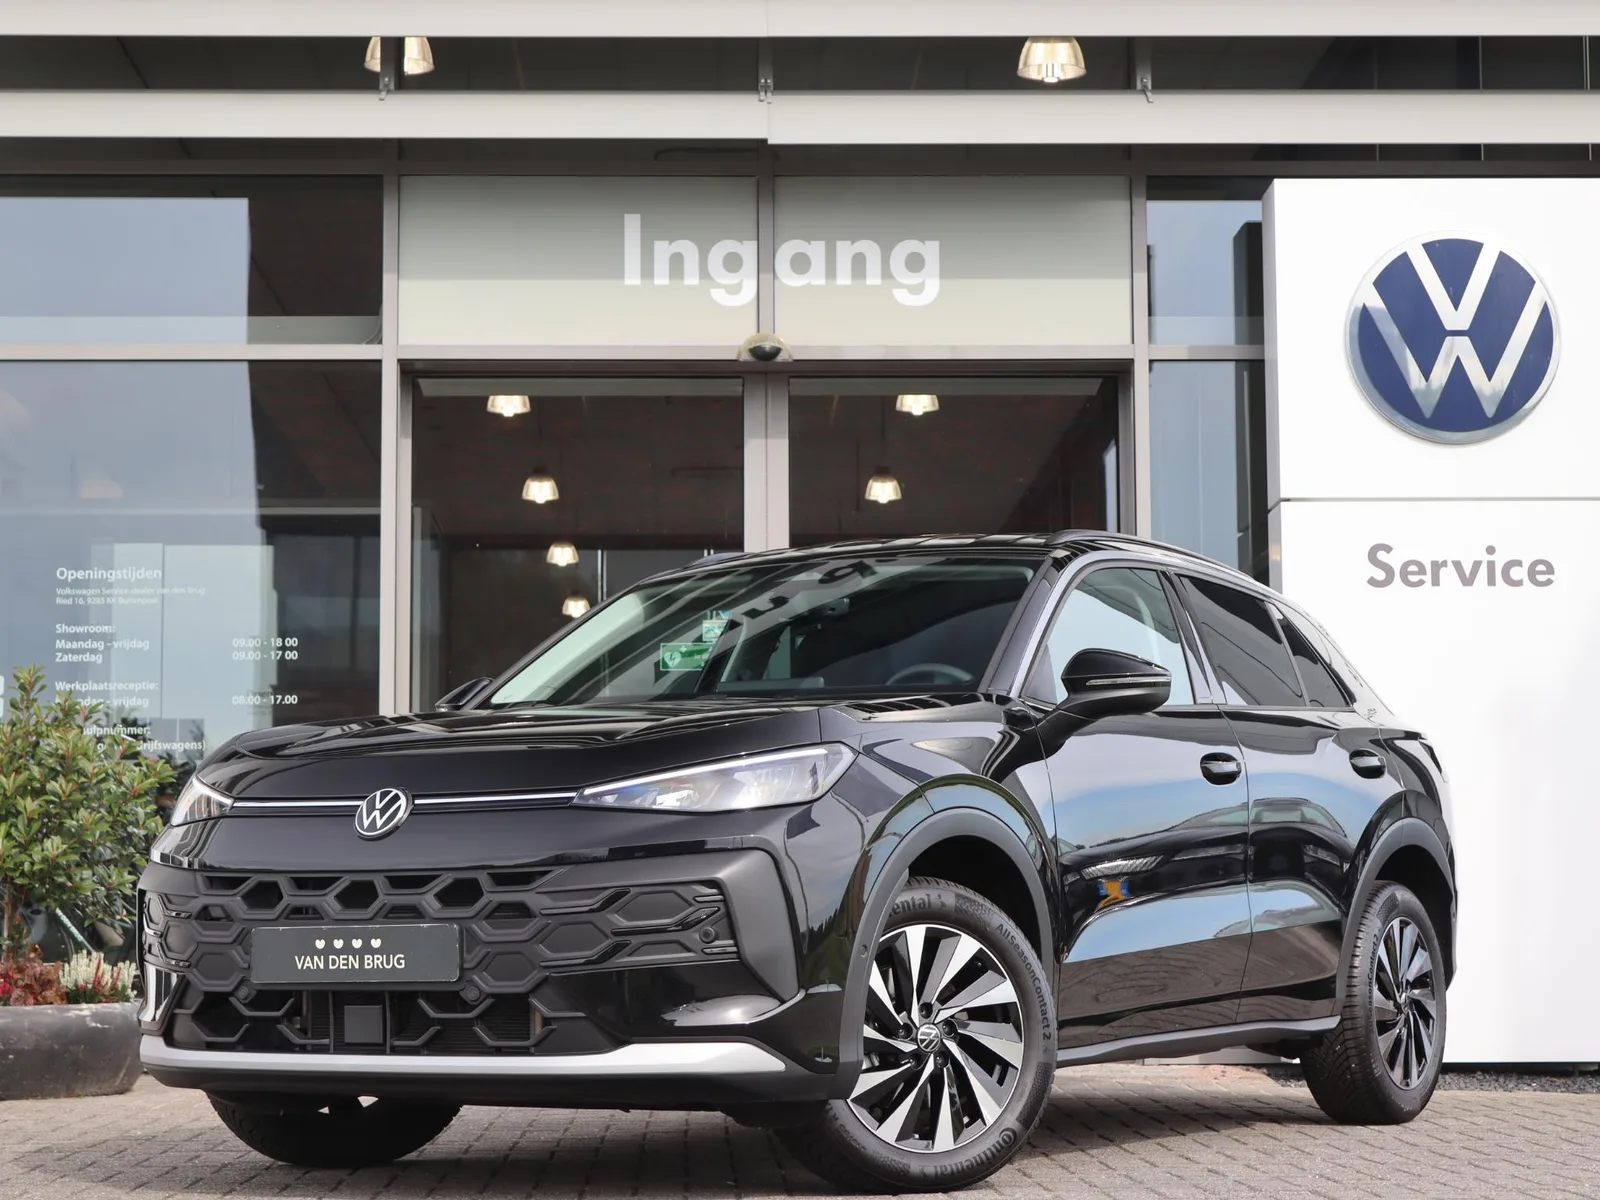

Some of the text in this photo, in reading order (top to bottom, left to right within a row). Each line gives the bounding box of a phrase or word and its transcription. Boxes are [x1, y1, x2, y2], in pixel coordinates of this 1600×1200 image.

[623, 213, 941, 307] Ingang
[1366, 543, 1556, 589] Service
[56, 566, 163, 583] Openingstijden
[55, 587, 101, 597] Volkswagen
[55, 597, 72, 605] Ried
[55, 623, 116, 635] Showroom:
[55, 638, 104, 651] Maandag
[112, 638, 150, 651] vrijdag
[232, 637, 261, 648] 09.00
[55, 652, 103, 664] Zaterdag
[232, 650, 261, 660] 09.00
[55, 680, 159, 693] Werkplaatsreceptie:
[112, 696, 150, 708] vrijdag
[232, 694, 261, 705] 08.00
[270, 694, 298, 705] 17.00
[294, 953, 406, 970] VAN DEN BRUG
[934, 1126, 1018, 1181] Continental
